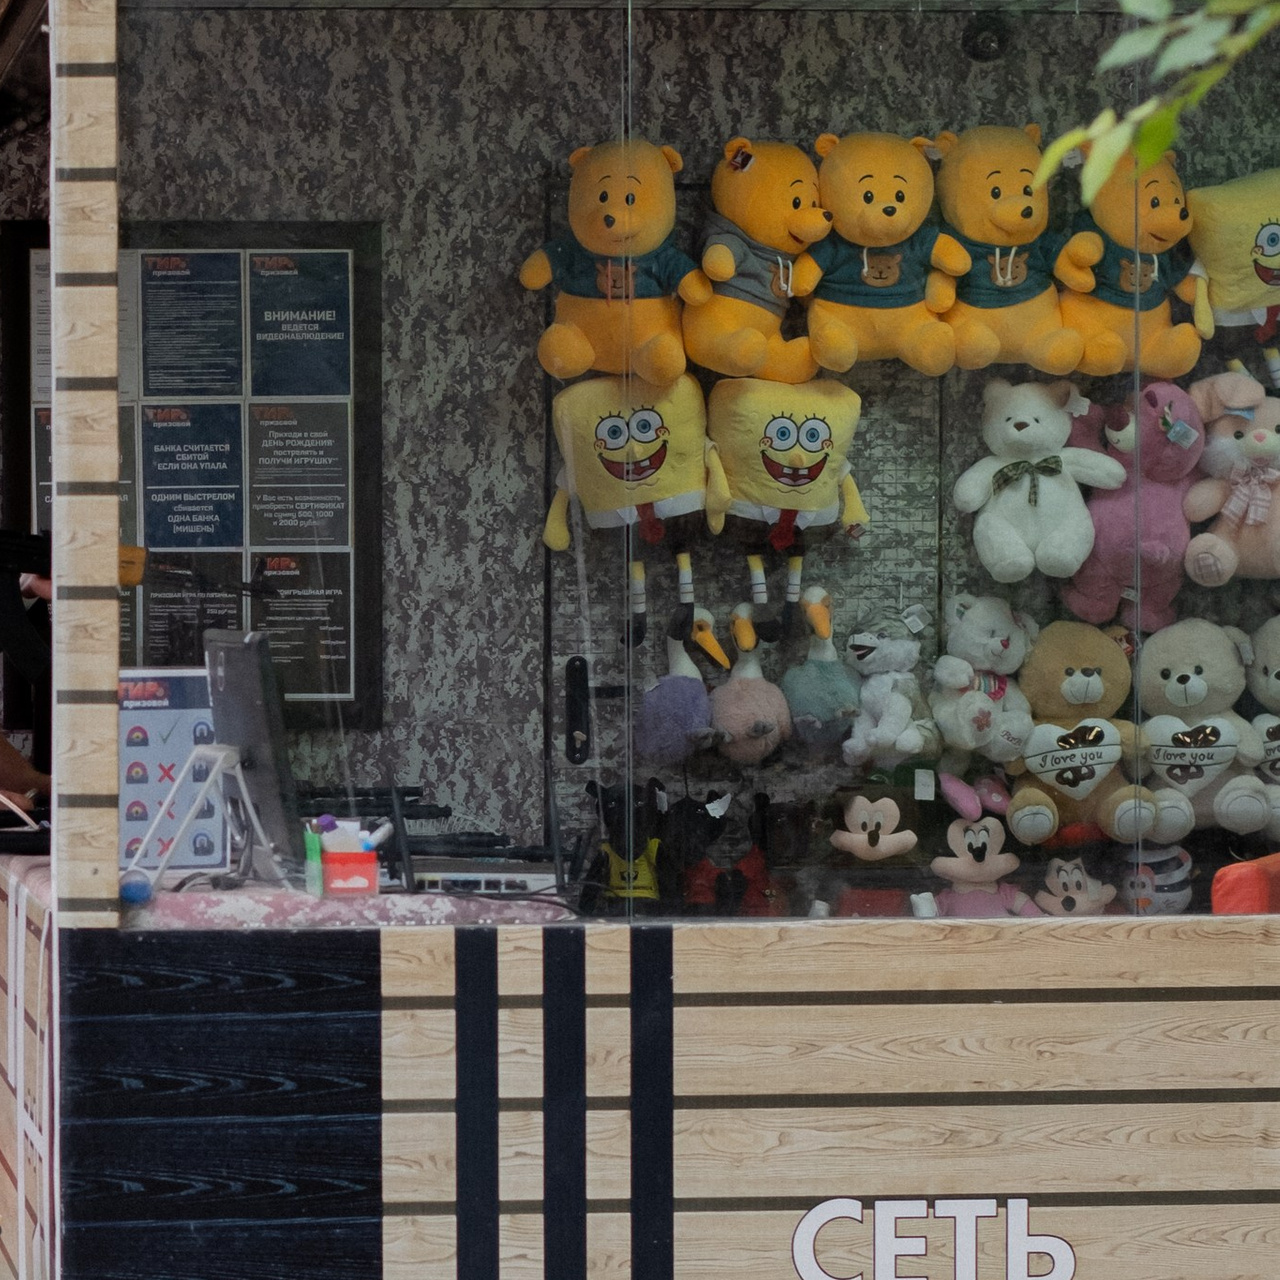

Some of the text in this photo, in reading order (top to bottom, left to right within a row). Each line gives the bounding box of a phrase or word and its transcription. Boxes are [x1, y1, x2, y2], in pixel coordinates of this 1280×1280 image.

[264, 310, 336, 321] ВНИМАНИЕ!
[281, 323, 319, 332] ВЕДЕТСЯ
[256, 332, 345, 341] ВИДЕОНАБЛЮДЕНИЕ!
[153, 443, 230, 452] БАНКА СЧИТАЕТСЯ
[261, 439, 285, 448] ДЕНЬ
[175, 452, 209, 461] СБИТОЙ
[258, 457, 293, 465] ПОЛУЧИ
[181, 462, 198, 470] ОНА
[199, 462, 228, 470] УПАЛА
[151, 492, 235, 502] ОДНИМ ВЫСТРЕЛОМ
[173, 503, 214, 512] сбивается
[167, 514, 220, 523] ОДНА БАНКА
[1051, 753, 1076, 766] love
[1080, 751, 1103, 766] you
[1163, 749, 1186, 761] love
[1190, 751, 1215, 765] you
